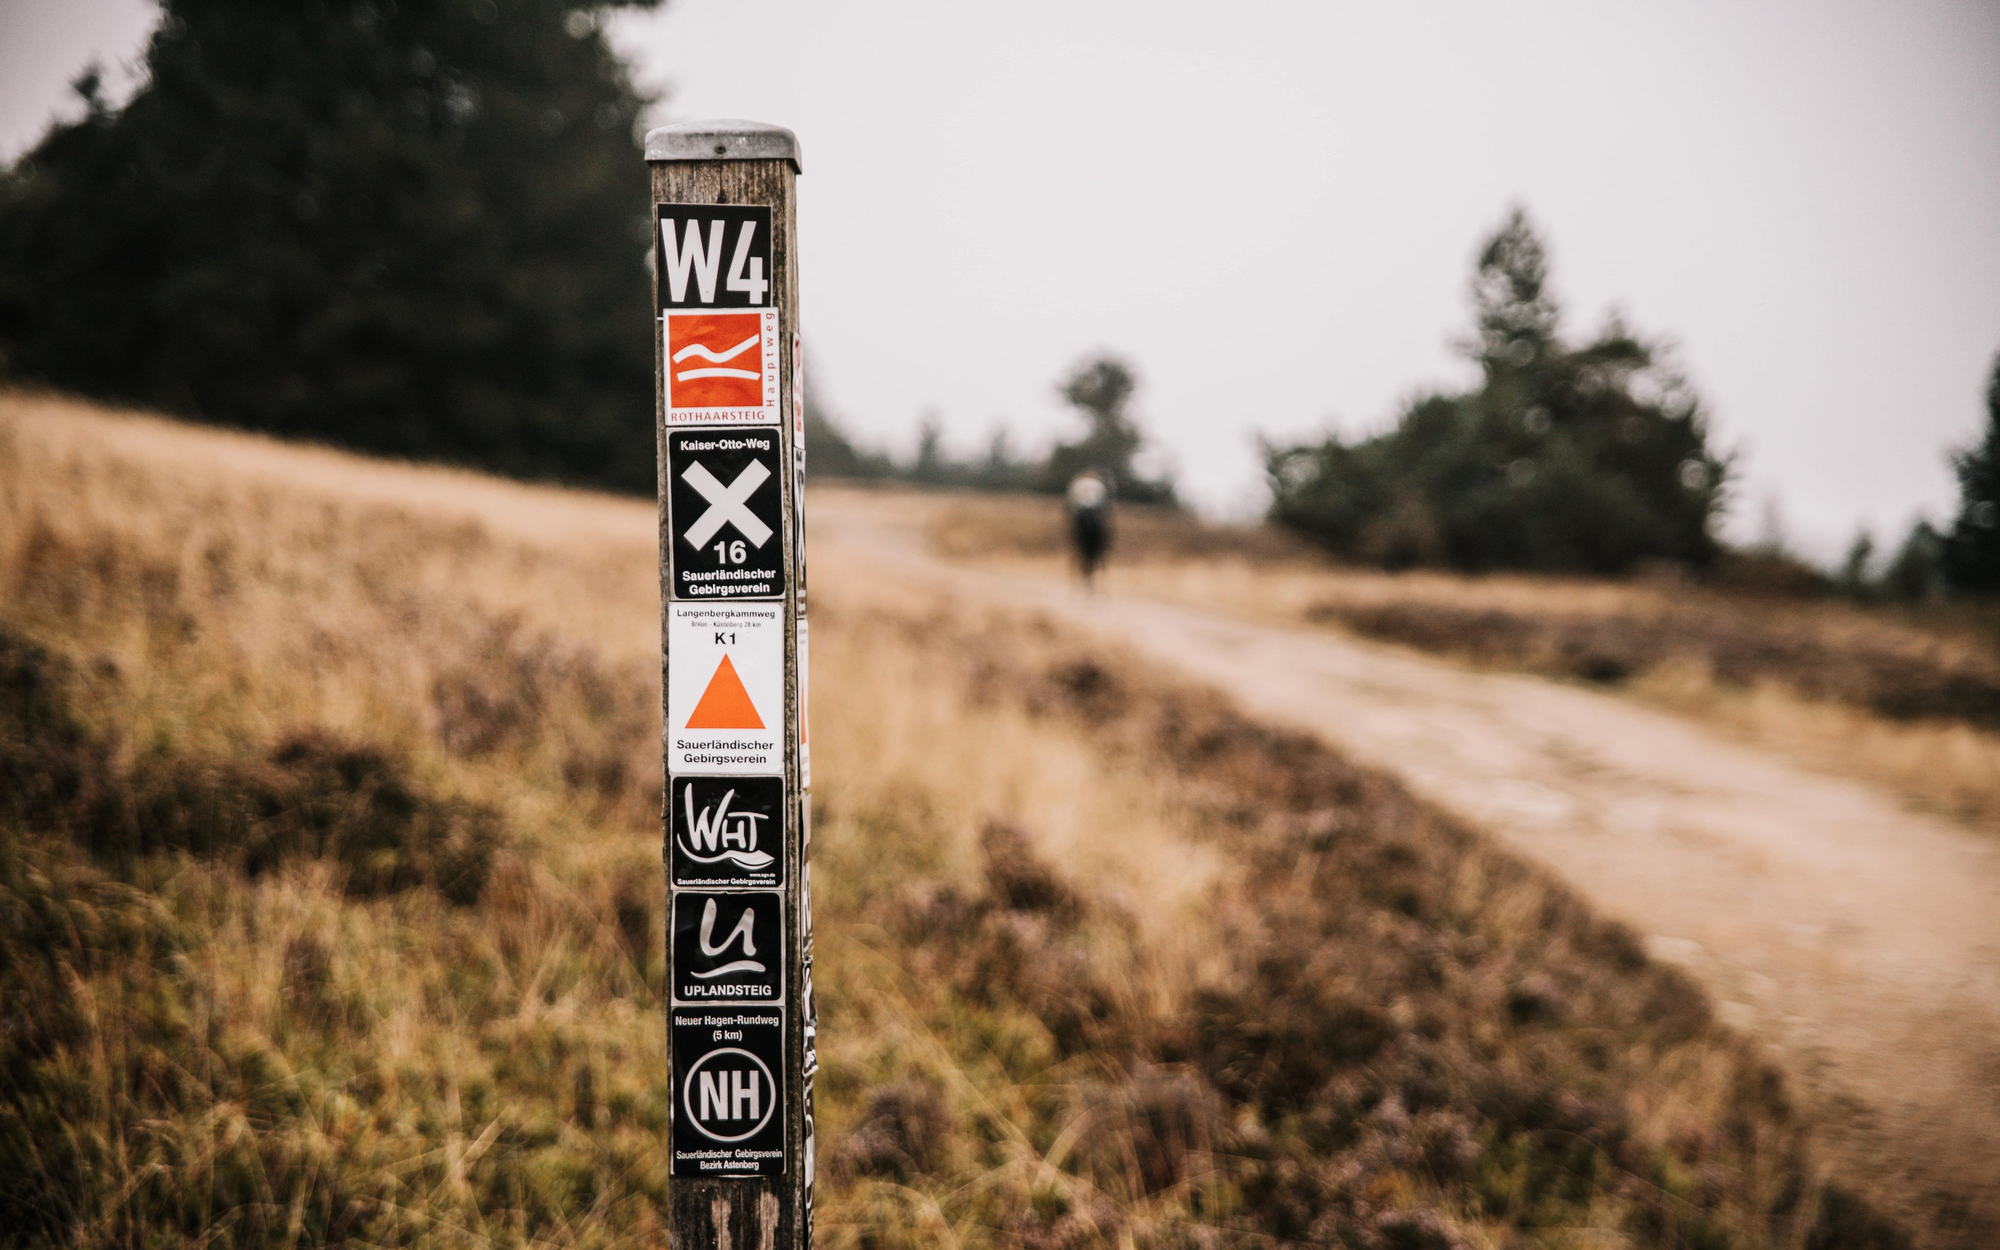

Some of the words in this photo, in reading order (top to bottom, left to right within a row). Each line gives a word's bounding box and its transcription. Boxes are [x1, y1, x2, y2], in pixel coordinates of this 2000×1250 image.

[661, 218, 768, 304] W4
[766, 313, 776, 407] Hauptweg
[671, 411, 765, 422] ROTHAARSTEIG
[680, 439, 771, 451] Kaiser-Otto-Weg
[714, 540, 747, 564] 16
[682, 569, 776, 581] Sauerländischer
[689, 583, 770, 597] Gebirgsverein
[677, 609, 775, 619] Langenbergkammweg
[676, 740, 774, 751] Sauerländischer
[684, 753, 767, 765] Gebirgsverein
[684, 782, 769, 852] WHT
[677, 877, 730, 885] Sauerländischer
[730, 877, 776, 887] Gebirgsverein
[684, 984, 772, 996] UPLANDSTEIG
[675, 1015, 702, 1026] Neuer
[704, 1015, 779, 1027] Hagen-Rundweg
[712, 1030, 722, 1041] (5
[724, 1030, 743, 1041] km)
[699, 1070, 759, 1121] NH
[676, 1149, 732, 1159] Sauerländischer
[735, 1149, 783, 1160] Gebirgsverein
[700, 1161, 722, 1170] Bezirk
[723, 1161, 760, 1171] Astenberg
